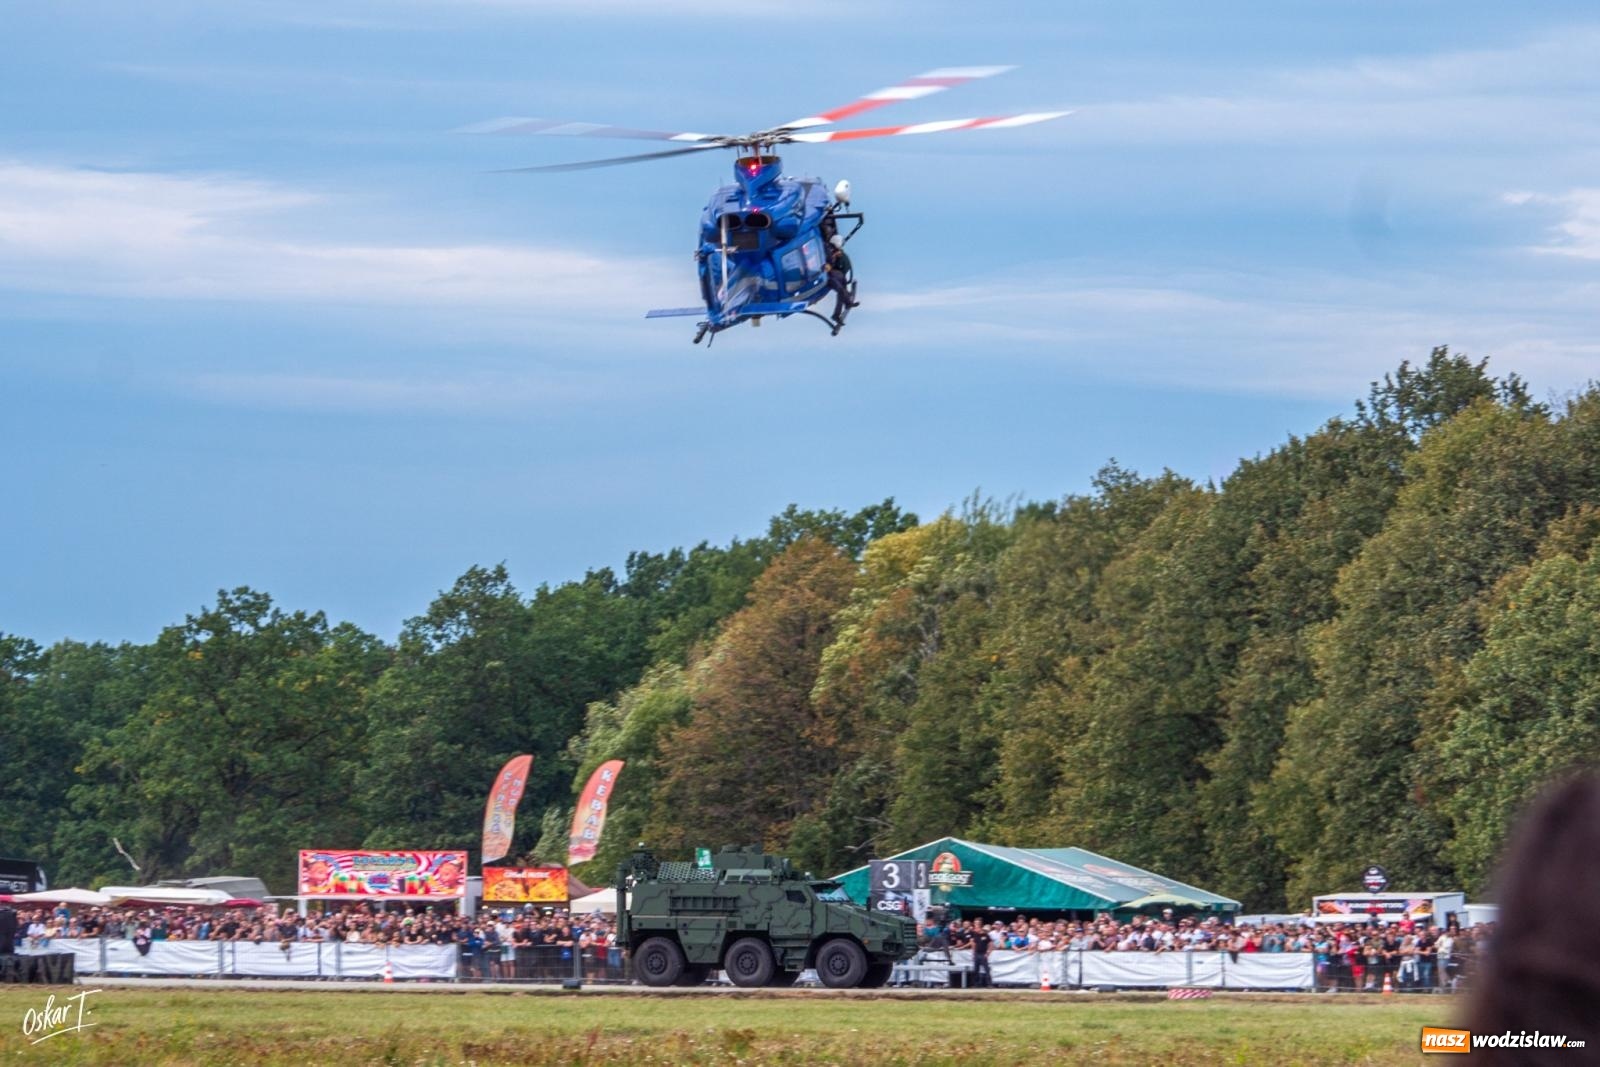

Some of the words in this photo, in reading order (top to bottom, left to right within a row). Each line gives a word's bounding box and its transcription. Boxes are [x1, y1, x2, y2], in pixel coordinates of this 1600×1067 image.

[582, 769, 614, 840] KEBAB
[881, 862, 901, 889] 3
[917, 862, 926, 888] 3
[877, 900, 901, 911] CSG
